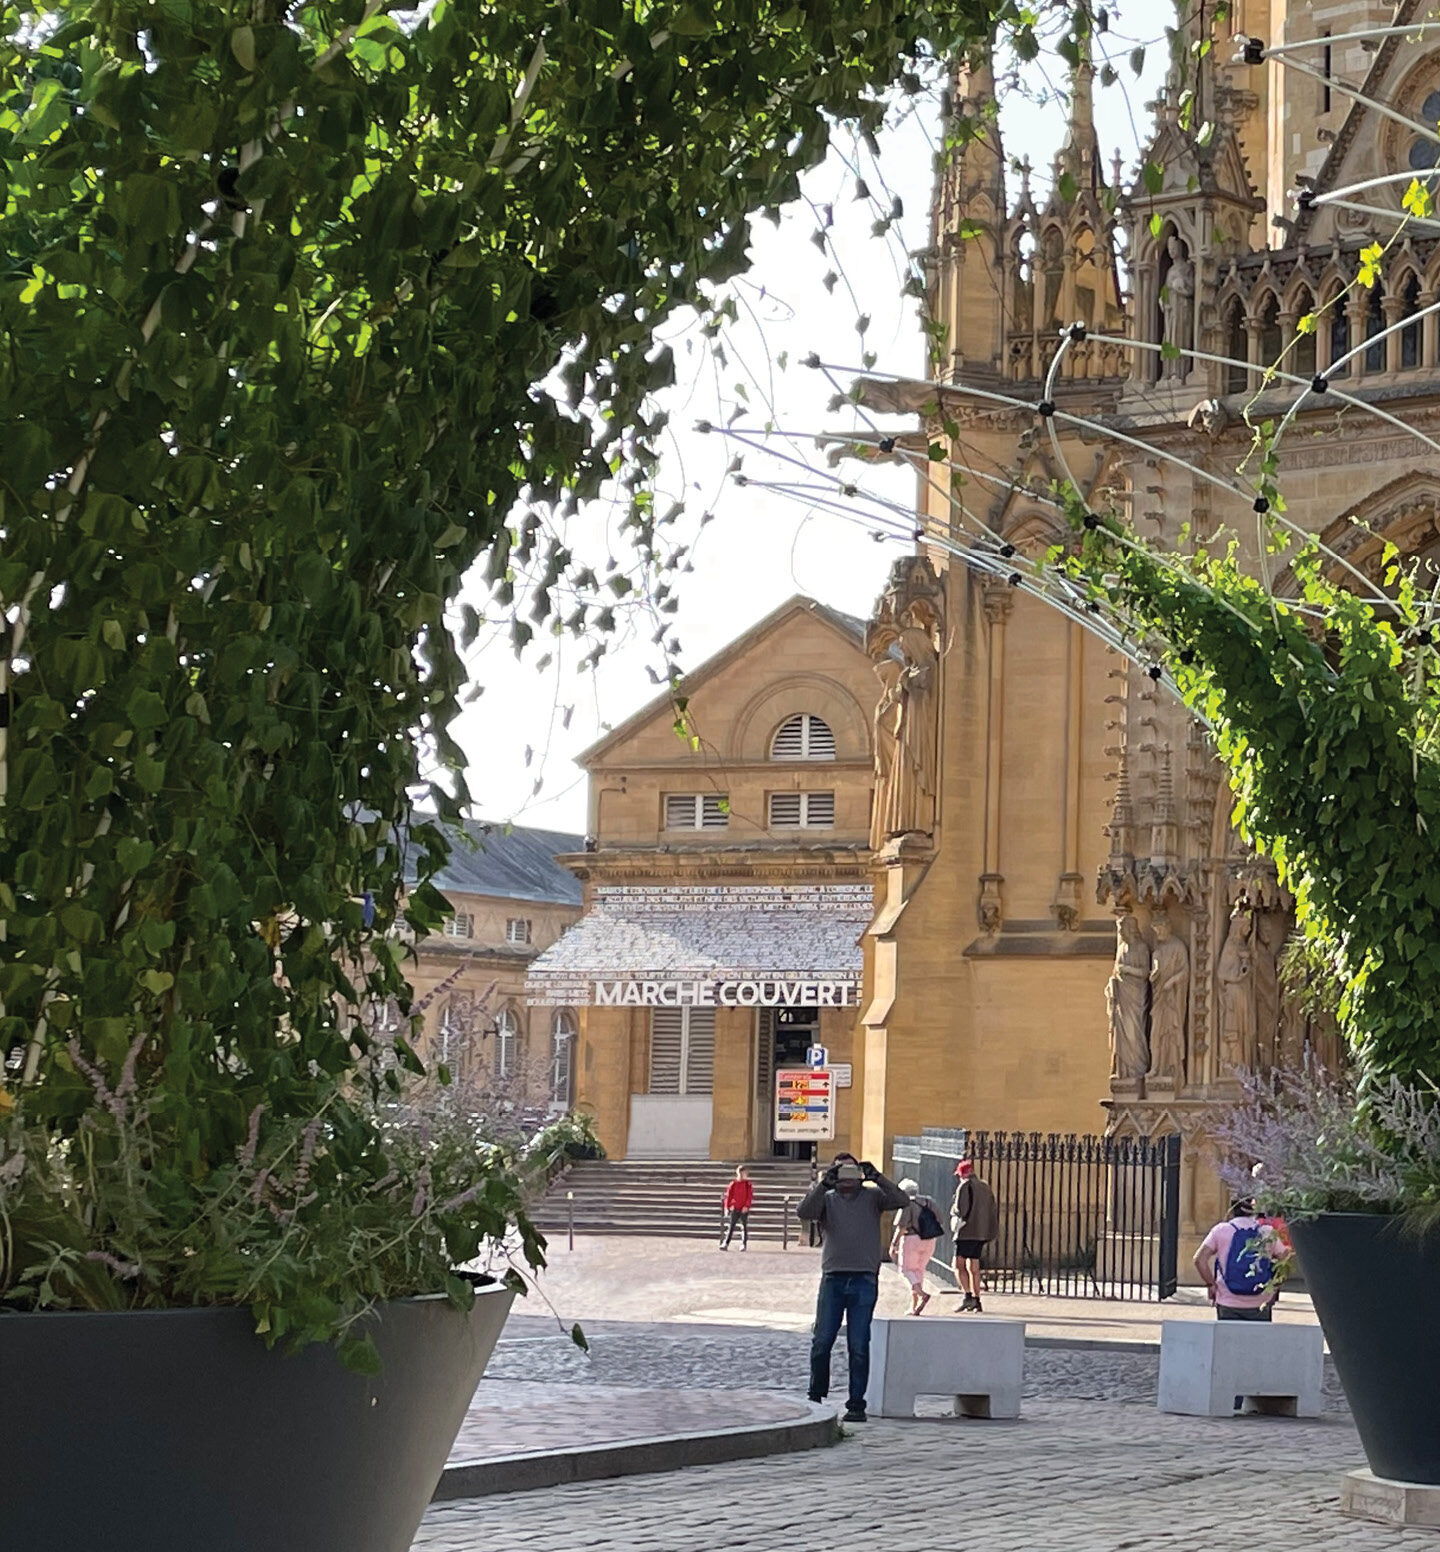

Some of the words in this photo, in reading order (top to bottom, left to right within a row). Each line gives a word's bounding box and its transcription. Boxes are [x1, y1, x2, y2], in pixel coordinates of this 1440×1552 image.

[595, 979, 715, 1006] MARCHÉ
[718, 982, 856, 1006] COUVERT
[811, 1050, 823, 1066] P
